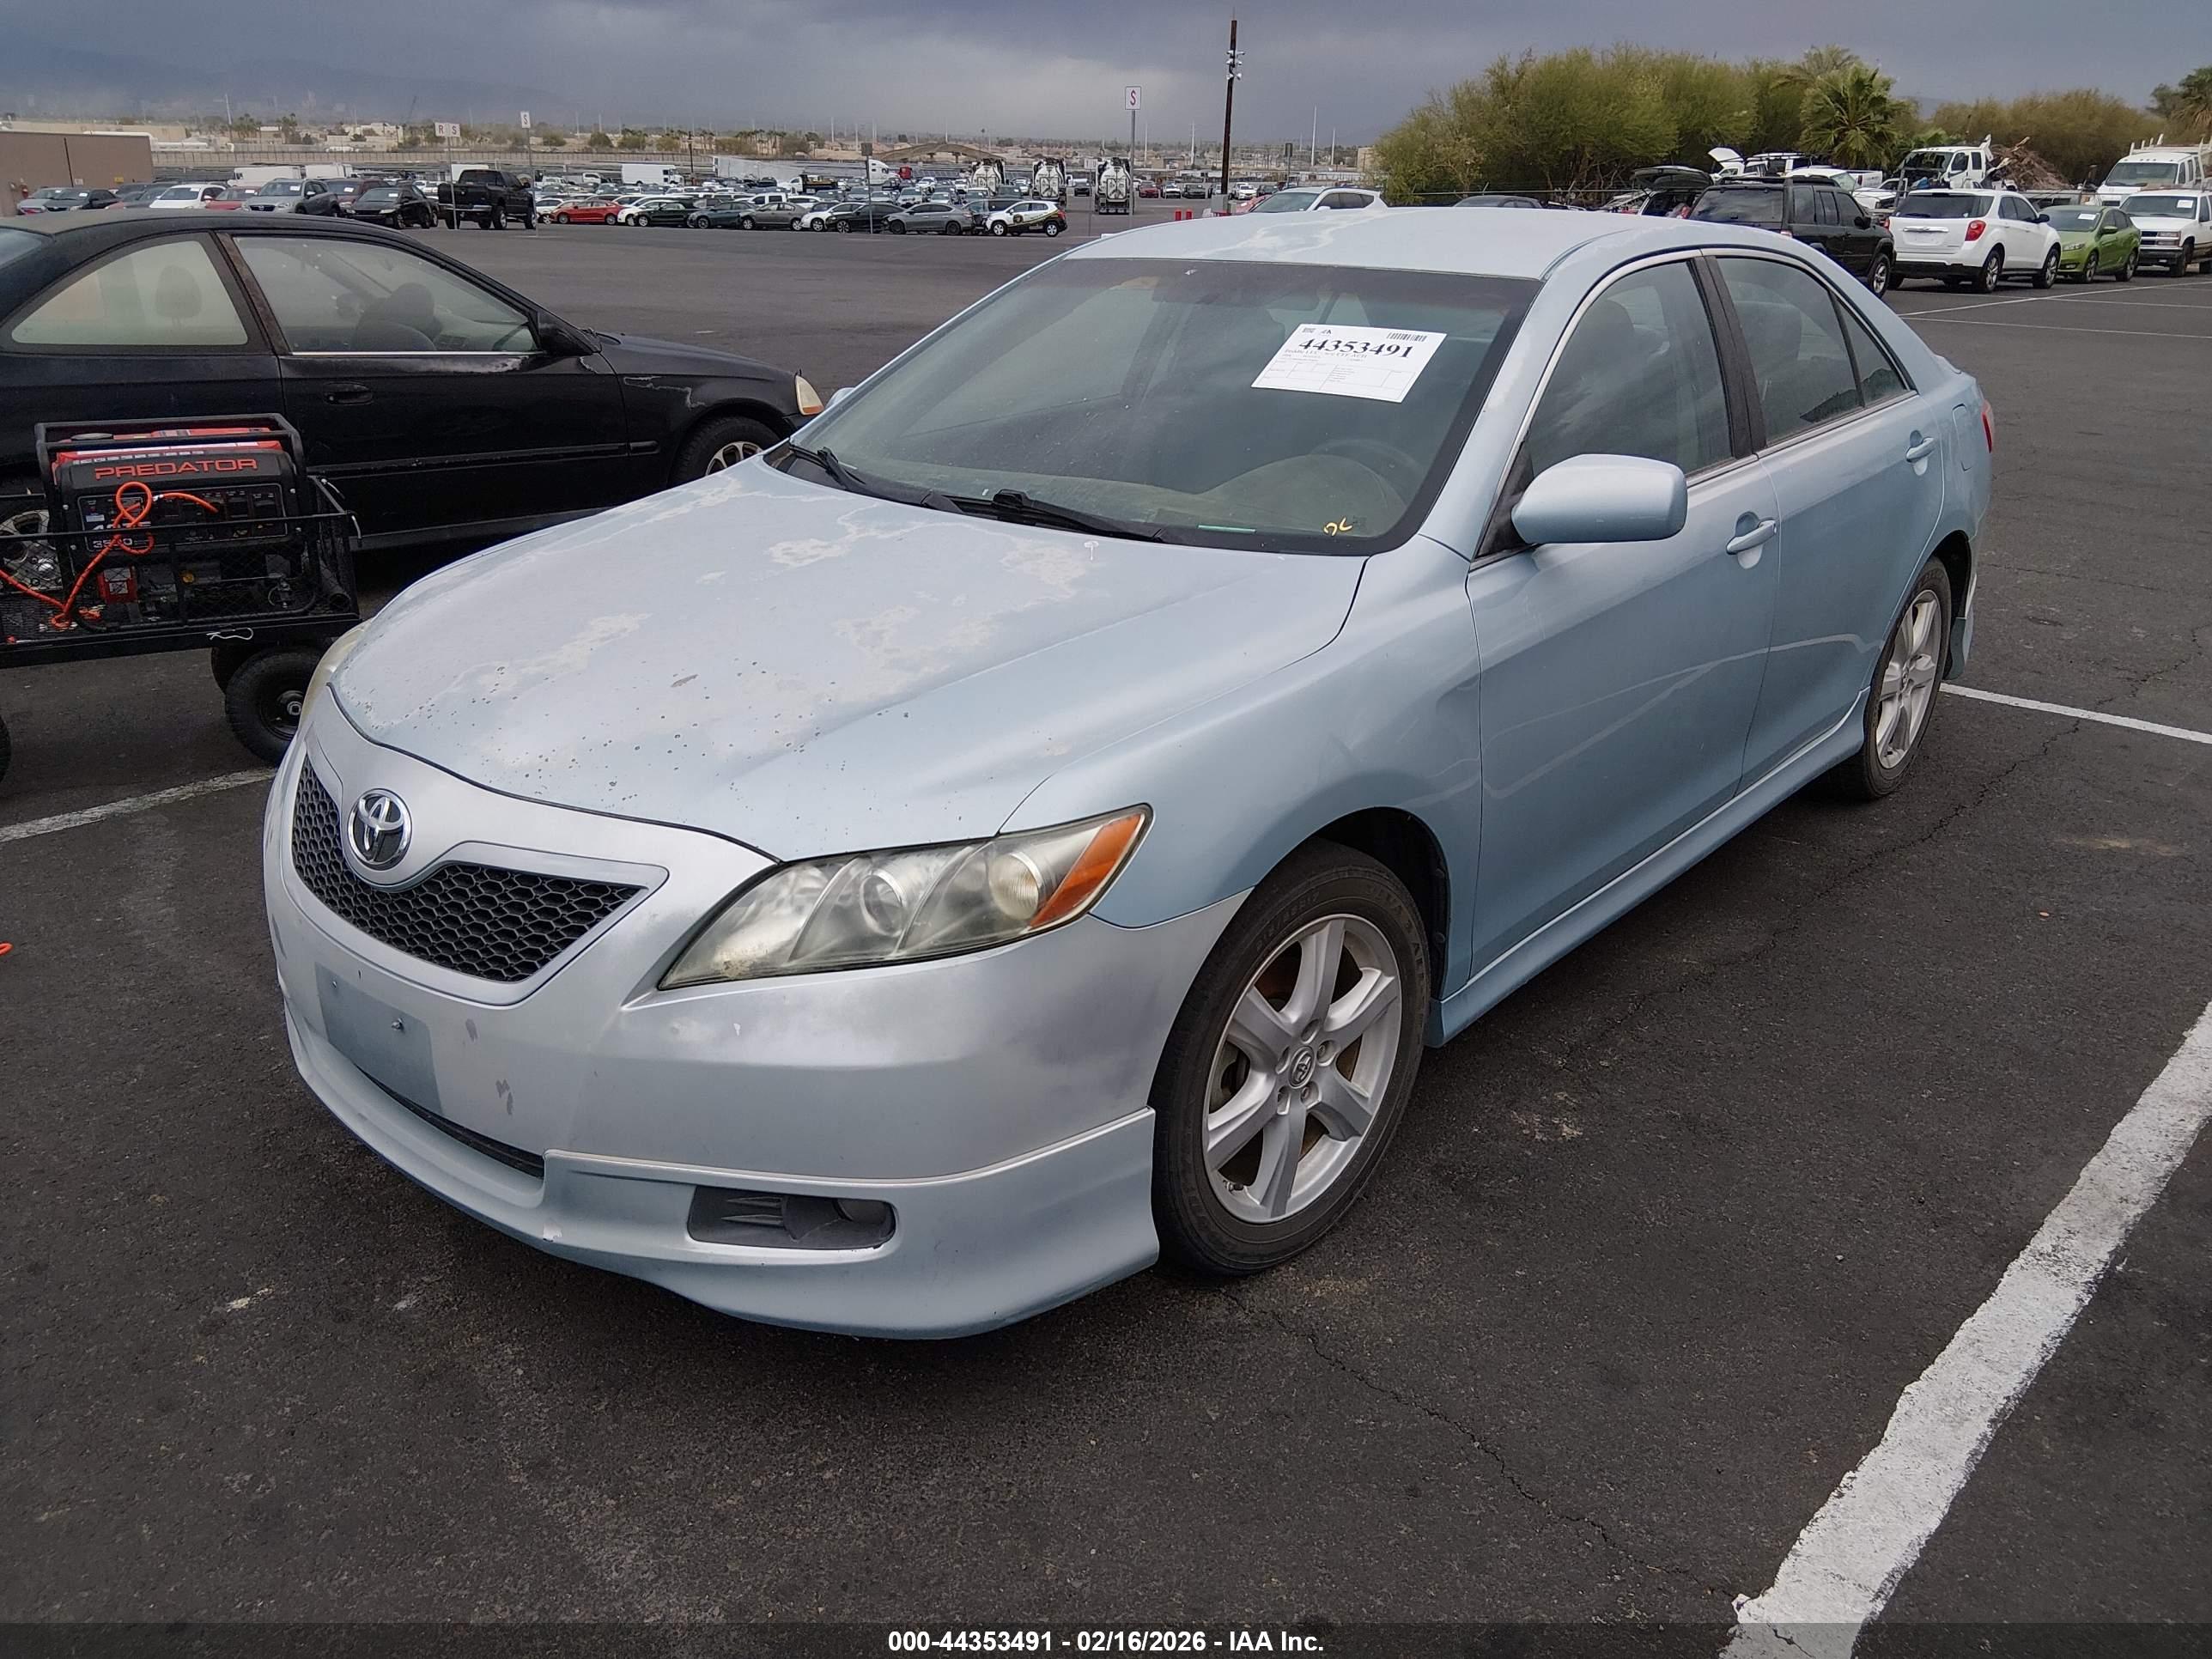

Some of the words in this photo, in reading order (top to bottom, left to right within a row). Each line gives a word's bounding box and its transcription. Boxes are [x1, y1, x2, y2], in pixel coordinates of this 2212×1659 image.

[1129, 88, 1136, 106] S
[438, 125, 444, 135] R
[452, 125, 457, 135] S
[1298, 338, 1413, 358] 44353491
[94, 459, 258, 480] PREDATOR
